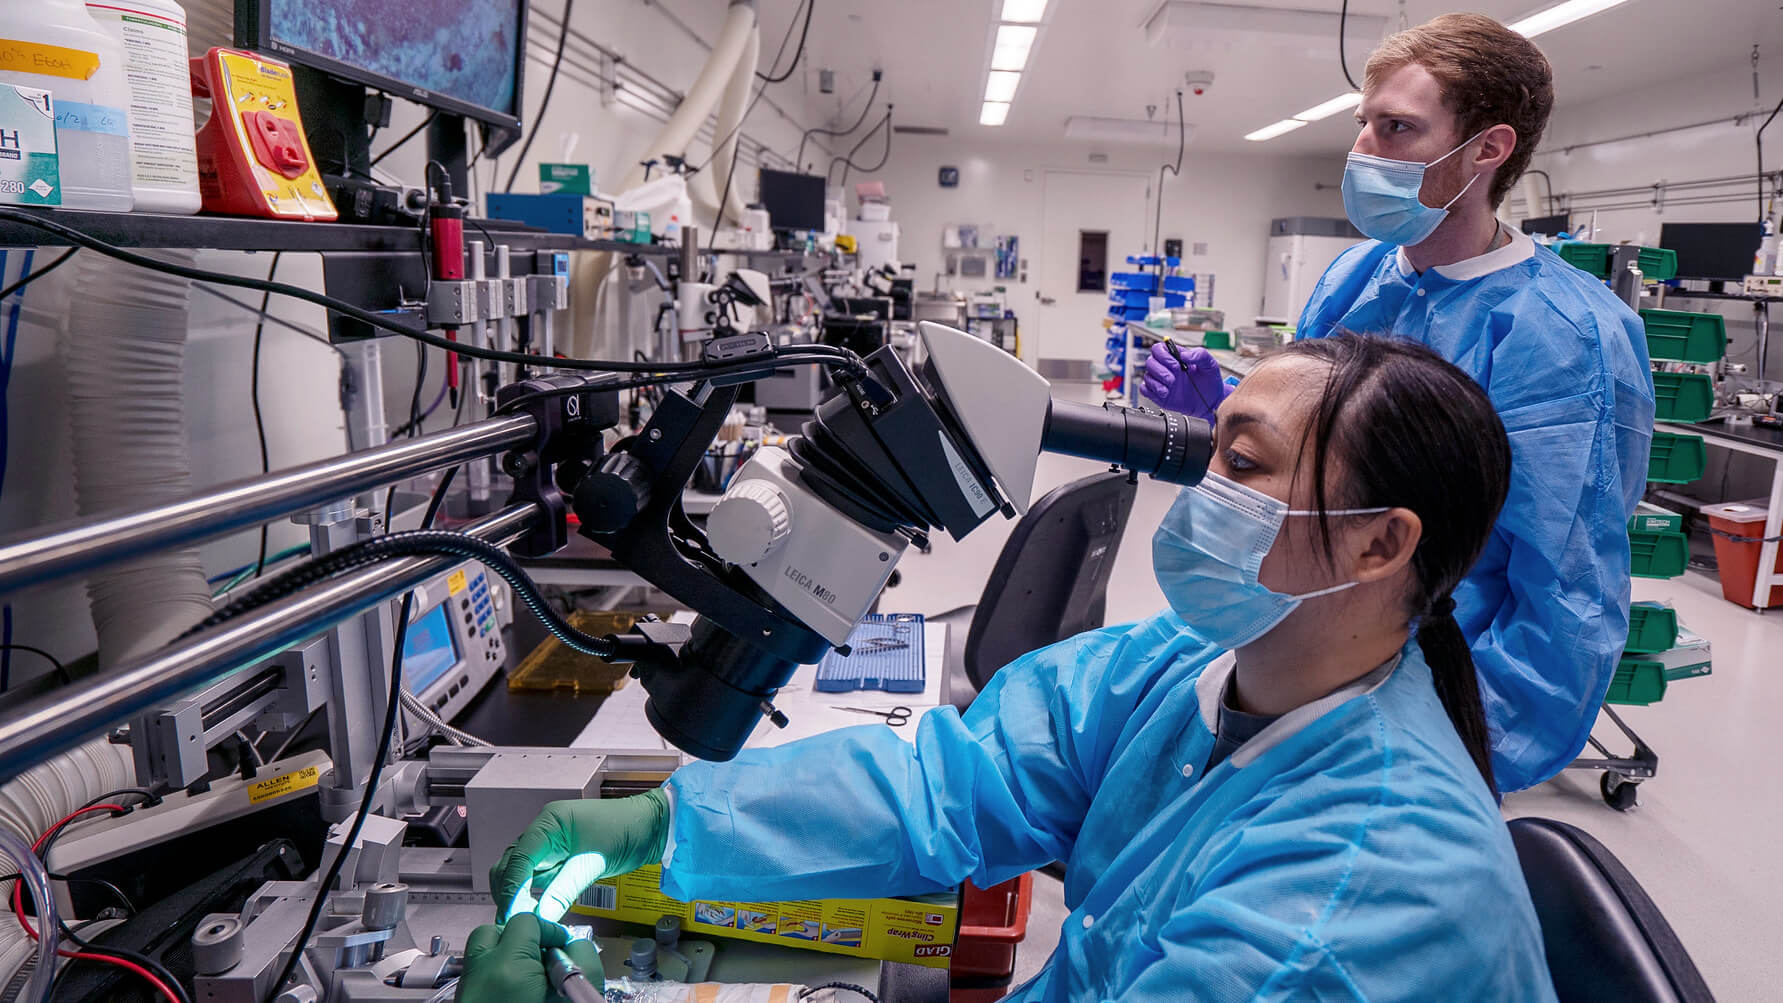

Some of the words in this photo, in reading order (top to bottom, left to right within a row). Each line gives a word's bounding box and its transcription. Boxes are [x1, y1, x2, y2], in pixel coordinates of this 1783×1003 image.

[0, 128, 20, 149] H
[1, 180, 25, 194] 280
[784, 565, 812, 591] LEICA
[812, 584, 837, 605] M80
[256, 775, 290, 789] ALLEN
[887, 927, 935, 942] ClingWrap
[915, 945, 952, 957] GLAD
